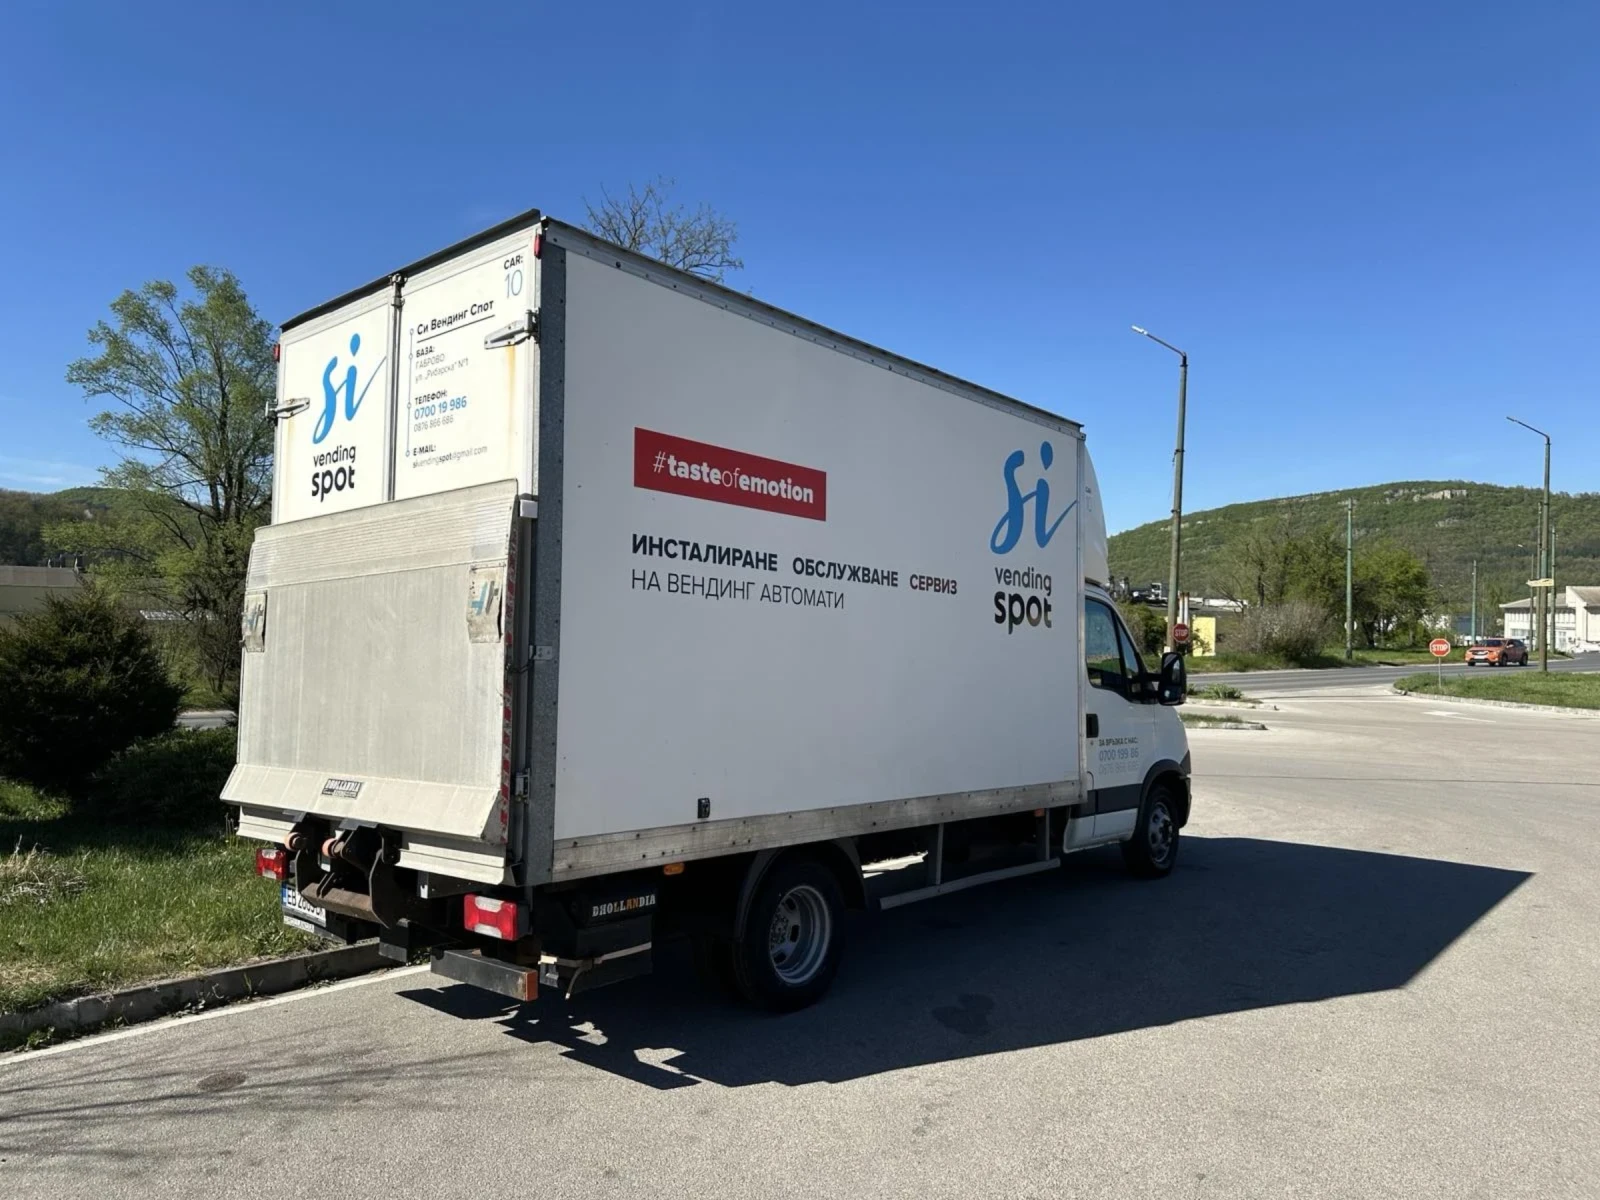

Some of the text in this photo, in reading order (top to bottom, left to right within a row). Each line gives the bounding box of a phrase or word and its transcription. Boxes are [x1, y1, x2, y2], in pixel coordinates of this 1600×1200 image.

[503, 254, 524, 270] CAR:
[504, 269, 523, 299] 10
[416, 300, 495, 335] Си Вендинг Спот
[415, 345, 436, 358] БАЗА:
[415, 353, 446, 370] ГАБРОВО
[413, 395, 467, 420] 0700 19 986
[414, 389, 447, 405] ТЕЛЕФОН:
[313, 445, 357, 468] vending
[311, 465, 356, 503] spot
[653, 450, 814, 504] #tasteofemotion
[632, 533, 958, 595] ИНСТАЛИРАНЕ ОБСЛУЖВАНЕ СЕРВИЗ
[631, 569, 845, 609] НА ВЕНДИНГ АВТОМАТИ
[994, 566, 1052, 596] vending
[993, 591, 1052, 635] spot
[1099, 749, 1116, 761] 0700
[592, 894, 656, 917] DHOLLANDIA
